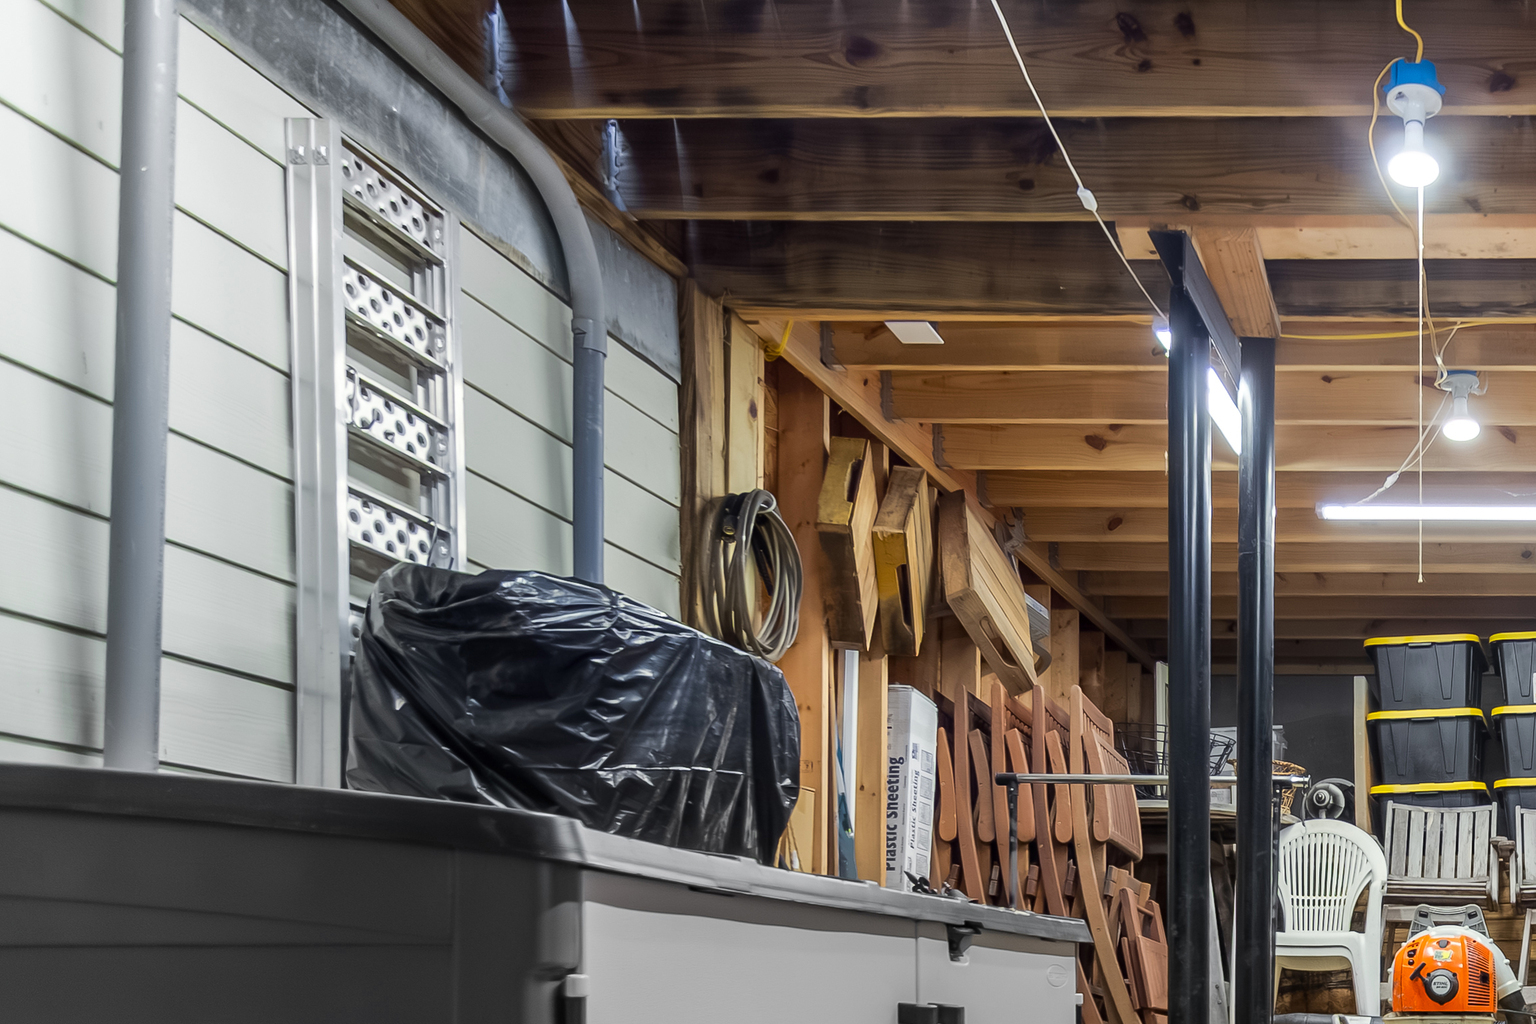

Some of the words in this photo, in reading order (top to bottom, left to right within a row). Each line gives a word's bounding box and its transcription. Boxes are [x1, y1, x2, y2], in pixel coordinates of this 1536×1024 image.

[886, 756, 905, 819] Sheeting
[911, 770, 921, 812] Sheeting
[886, 824, 898, 872] Plastic
